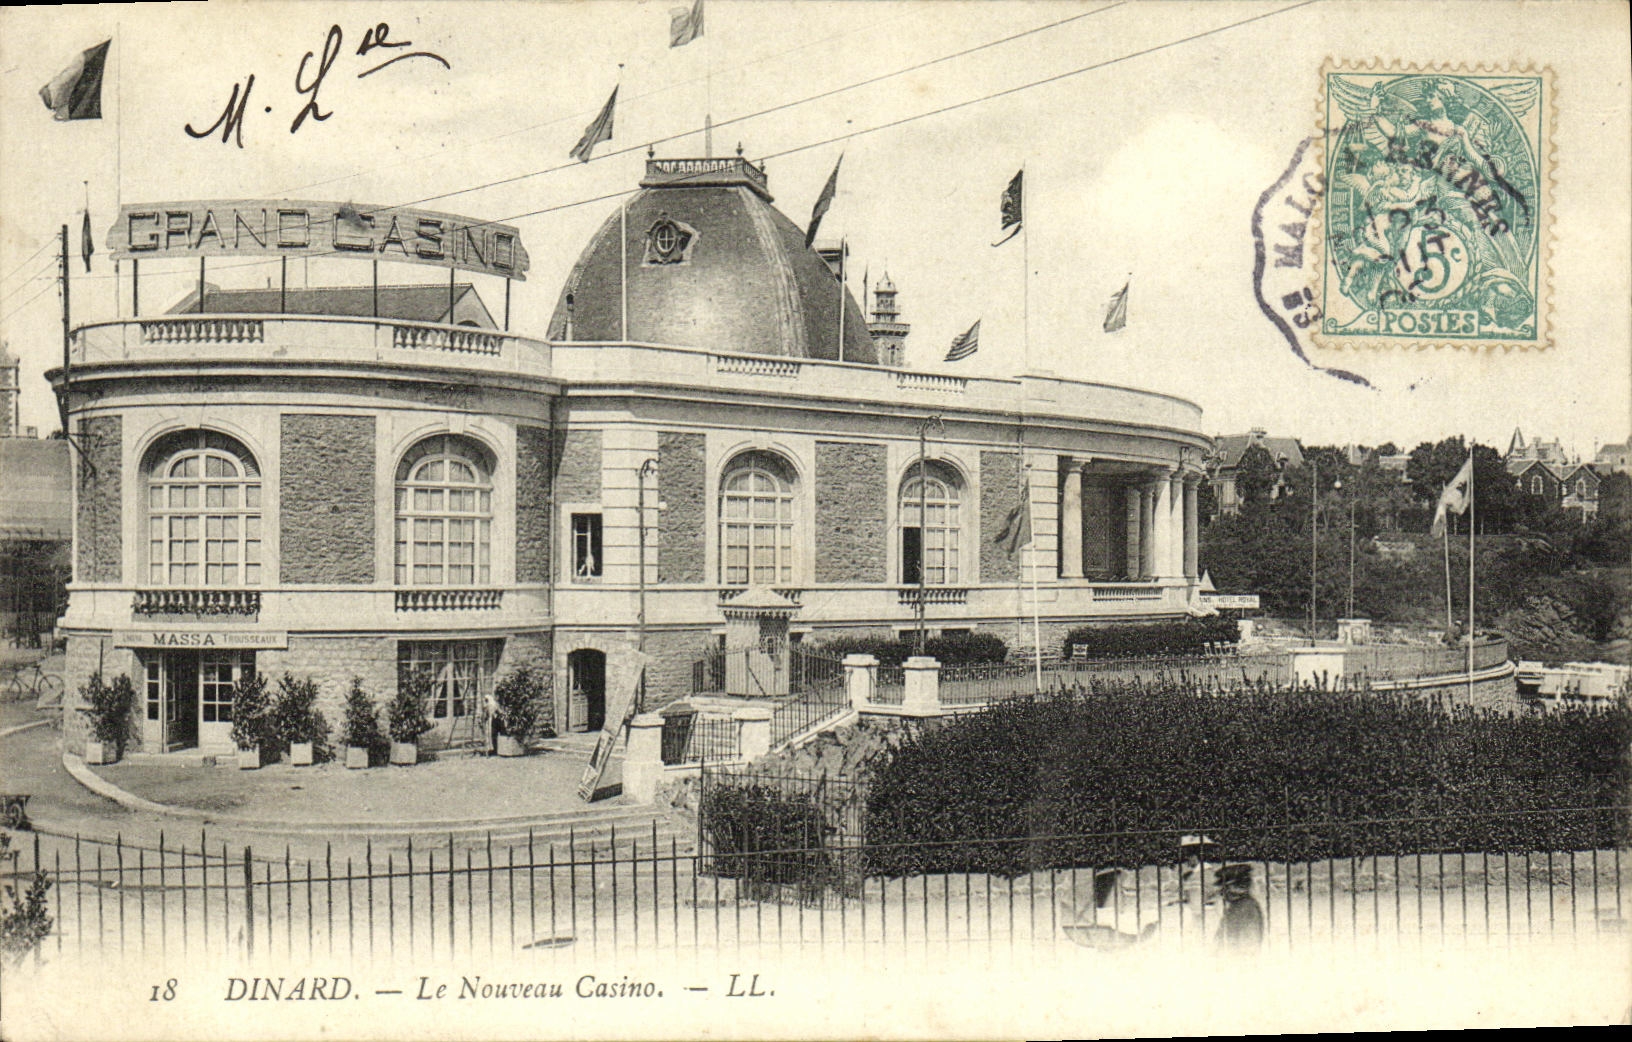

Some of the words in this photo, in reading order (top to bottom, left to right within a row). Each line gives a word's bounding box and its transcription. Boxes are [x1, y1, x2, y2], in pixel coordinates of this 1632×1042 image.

[127, 208, 311, 252] GRAND
[332, 209, 516, 270] CASINO
[1381, 311, 1476, 335] POSTES
[153, 633, 216, 646] MASSA
[223, 633, 277, 644] TROUSSEAUX
